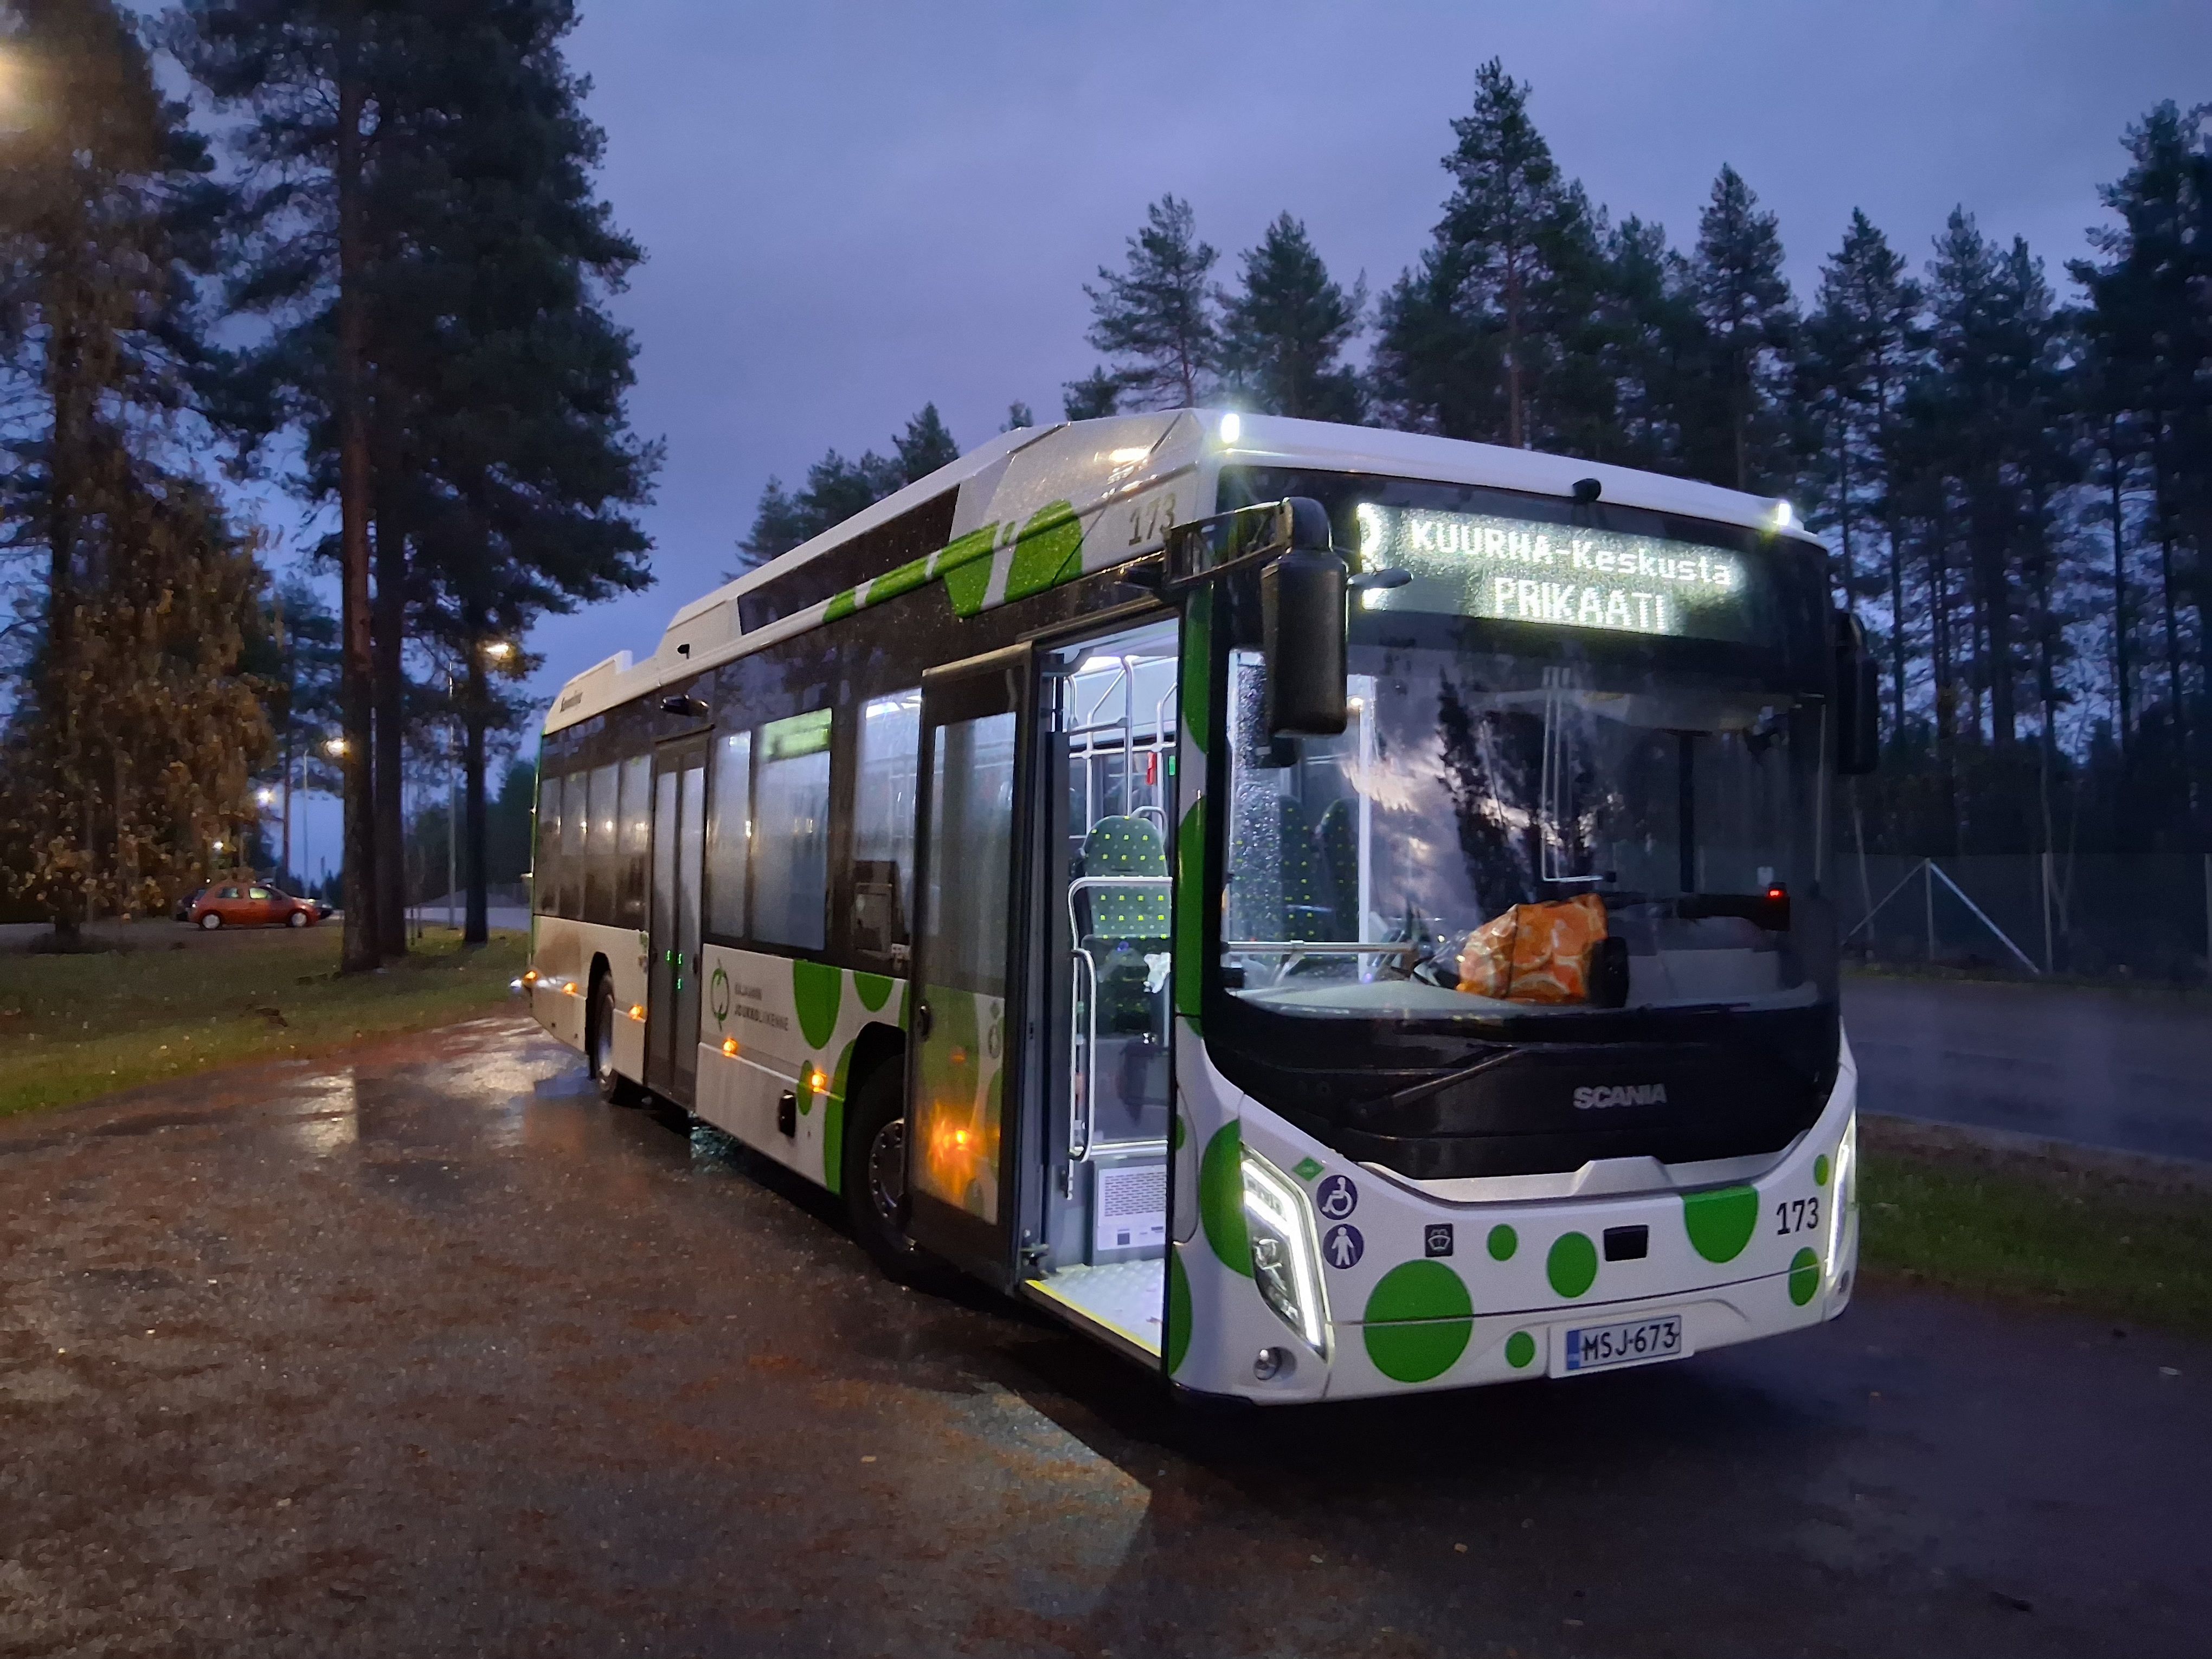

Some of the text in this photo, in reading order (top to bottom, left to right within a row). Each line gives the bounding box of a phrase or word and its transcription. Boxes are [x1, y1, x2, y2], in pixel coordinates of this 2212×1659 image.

[1128, 492, 1175, 545] 173
[1494, 576, 1666, 629] PRIKAATI
[1573, 1084, 1668, 1109] SCANIA
[1776, 1197, 1818, 1236] 173
[1584, 1322, 1676, 1361] MSJ-673
